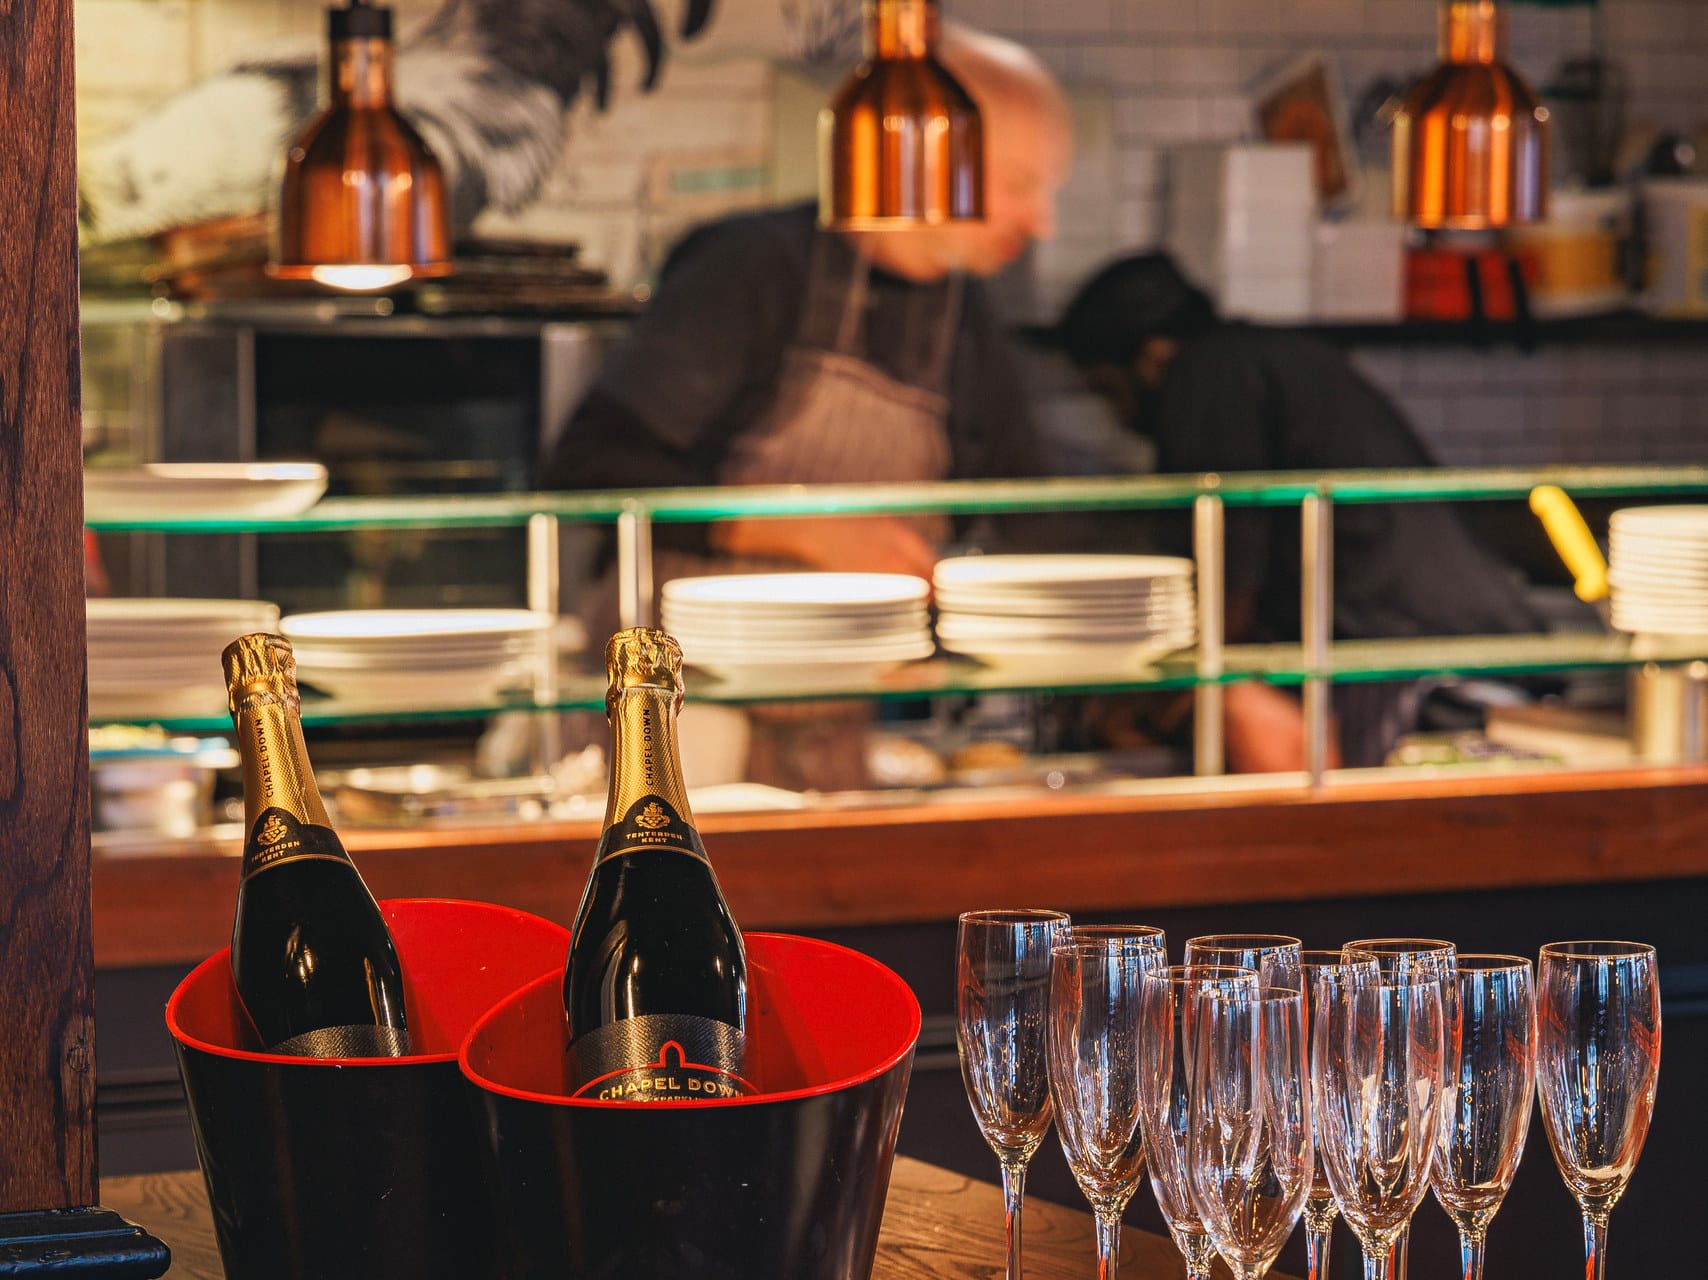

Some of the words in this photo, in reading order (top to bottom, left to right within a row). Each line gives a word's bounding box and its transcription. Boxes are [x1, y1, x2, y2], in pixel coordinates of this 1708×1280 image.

[255, 718, 267, 753] DOWN
[643, 709, 652, 742] DOWN
[261, 755, 274, 798] CHAPEL
[644, 745, 653, 786] CHAPEL
[625, 831, 683, 840] TENTERDEN
[261, 850, 284, 863] KENT
[599, 1077, 681, 1100] CHAPEL
